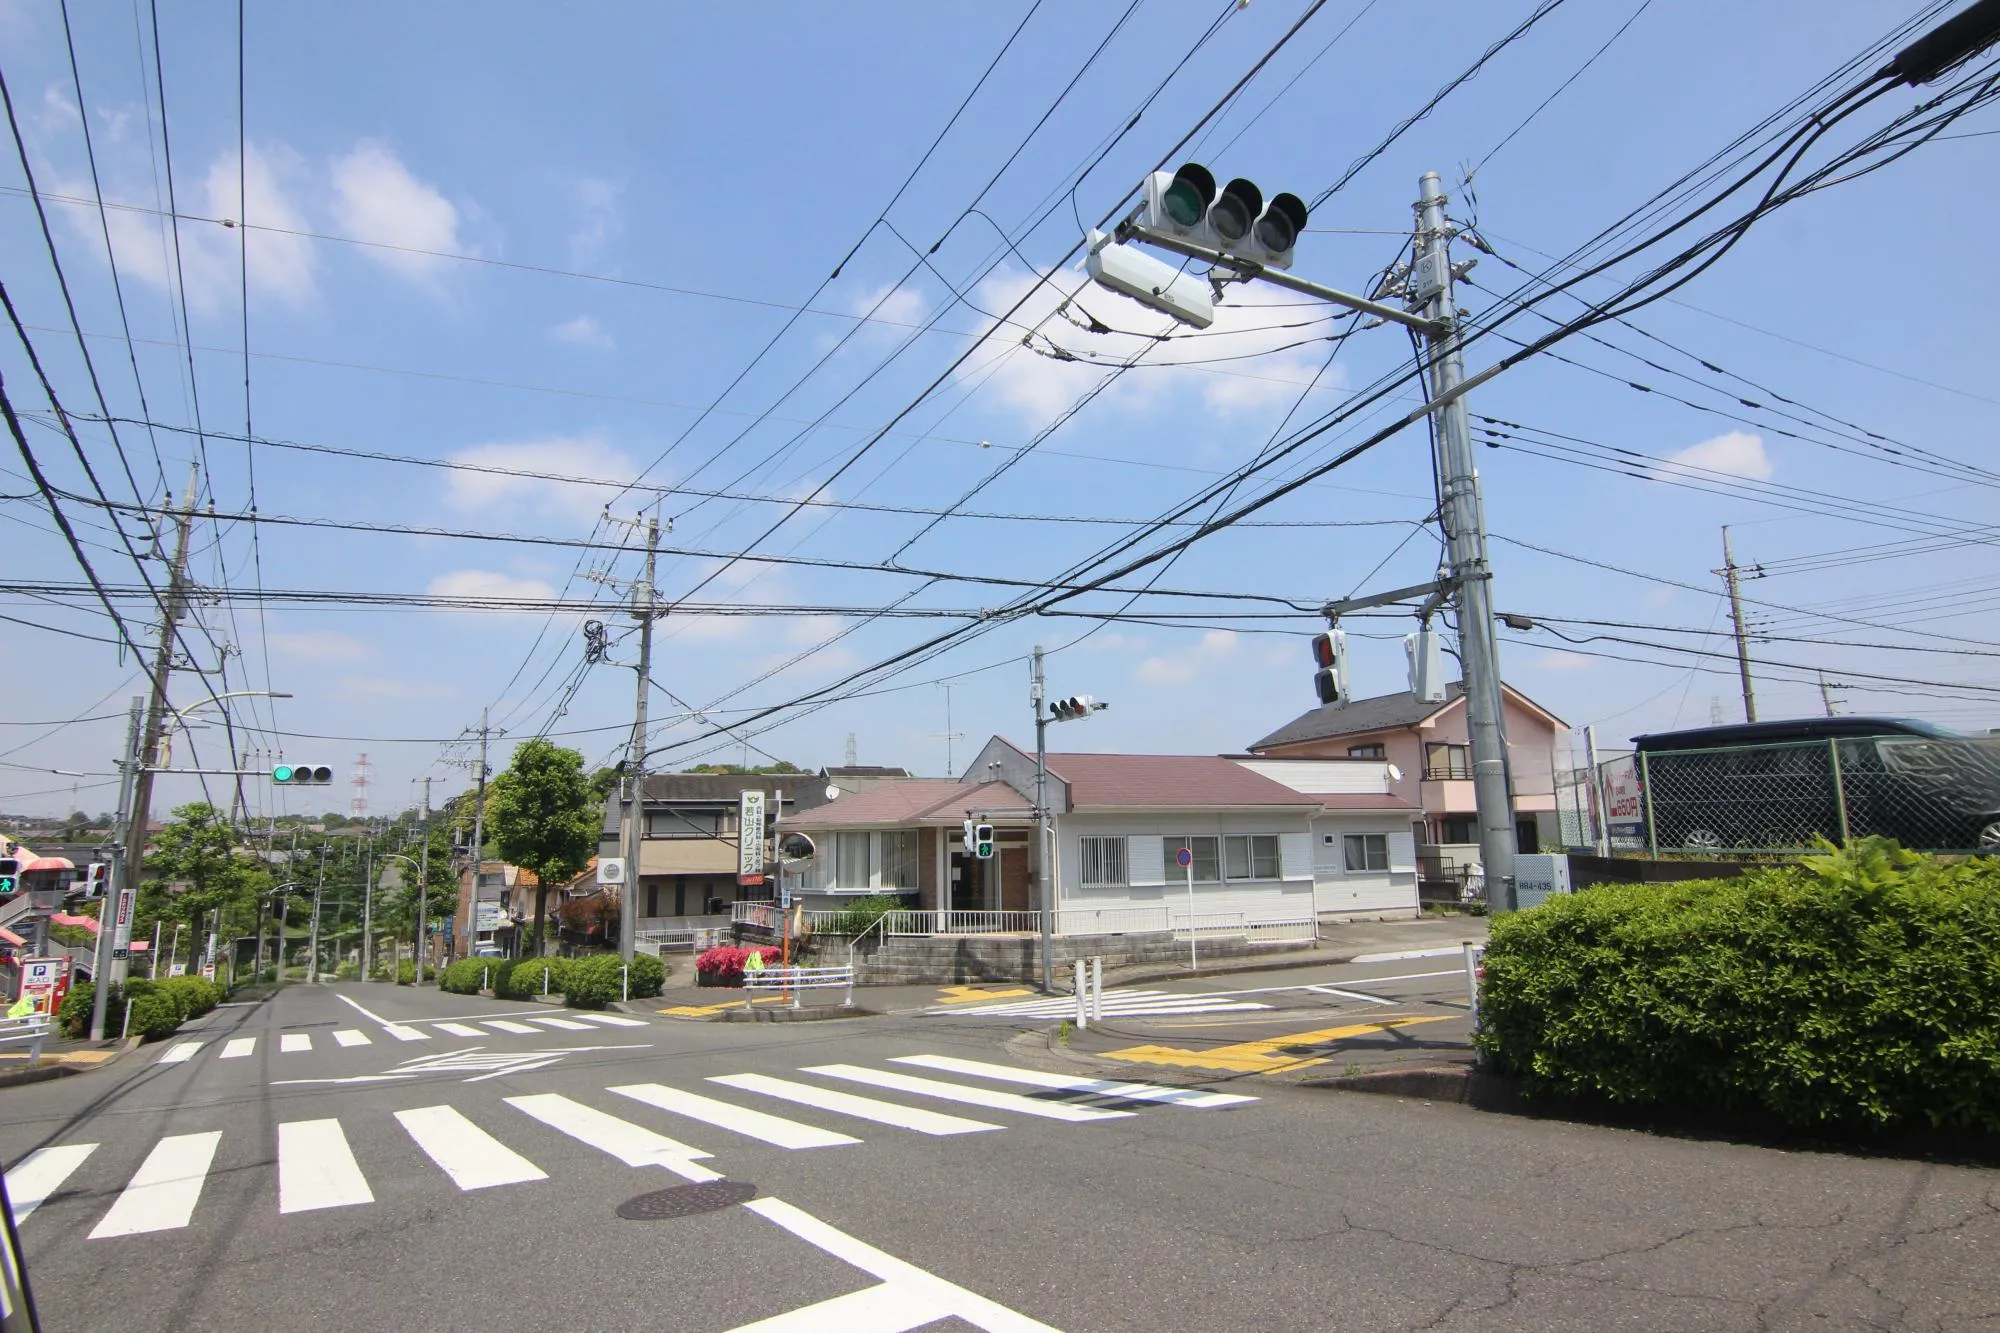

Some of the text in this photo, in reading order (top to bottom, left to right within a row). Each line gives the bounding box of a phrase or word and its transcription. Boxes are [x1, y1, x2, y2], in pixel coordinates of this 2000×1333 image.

[743, 806, 754, 874] 若山クリニック
